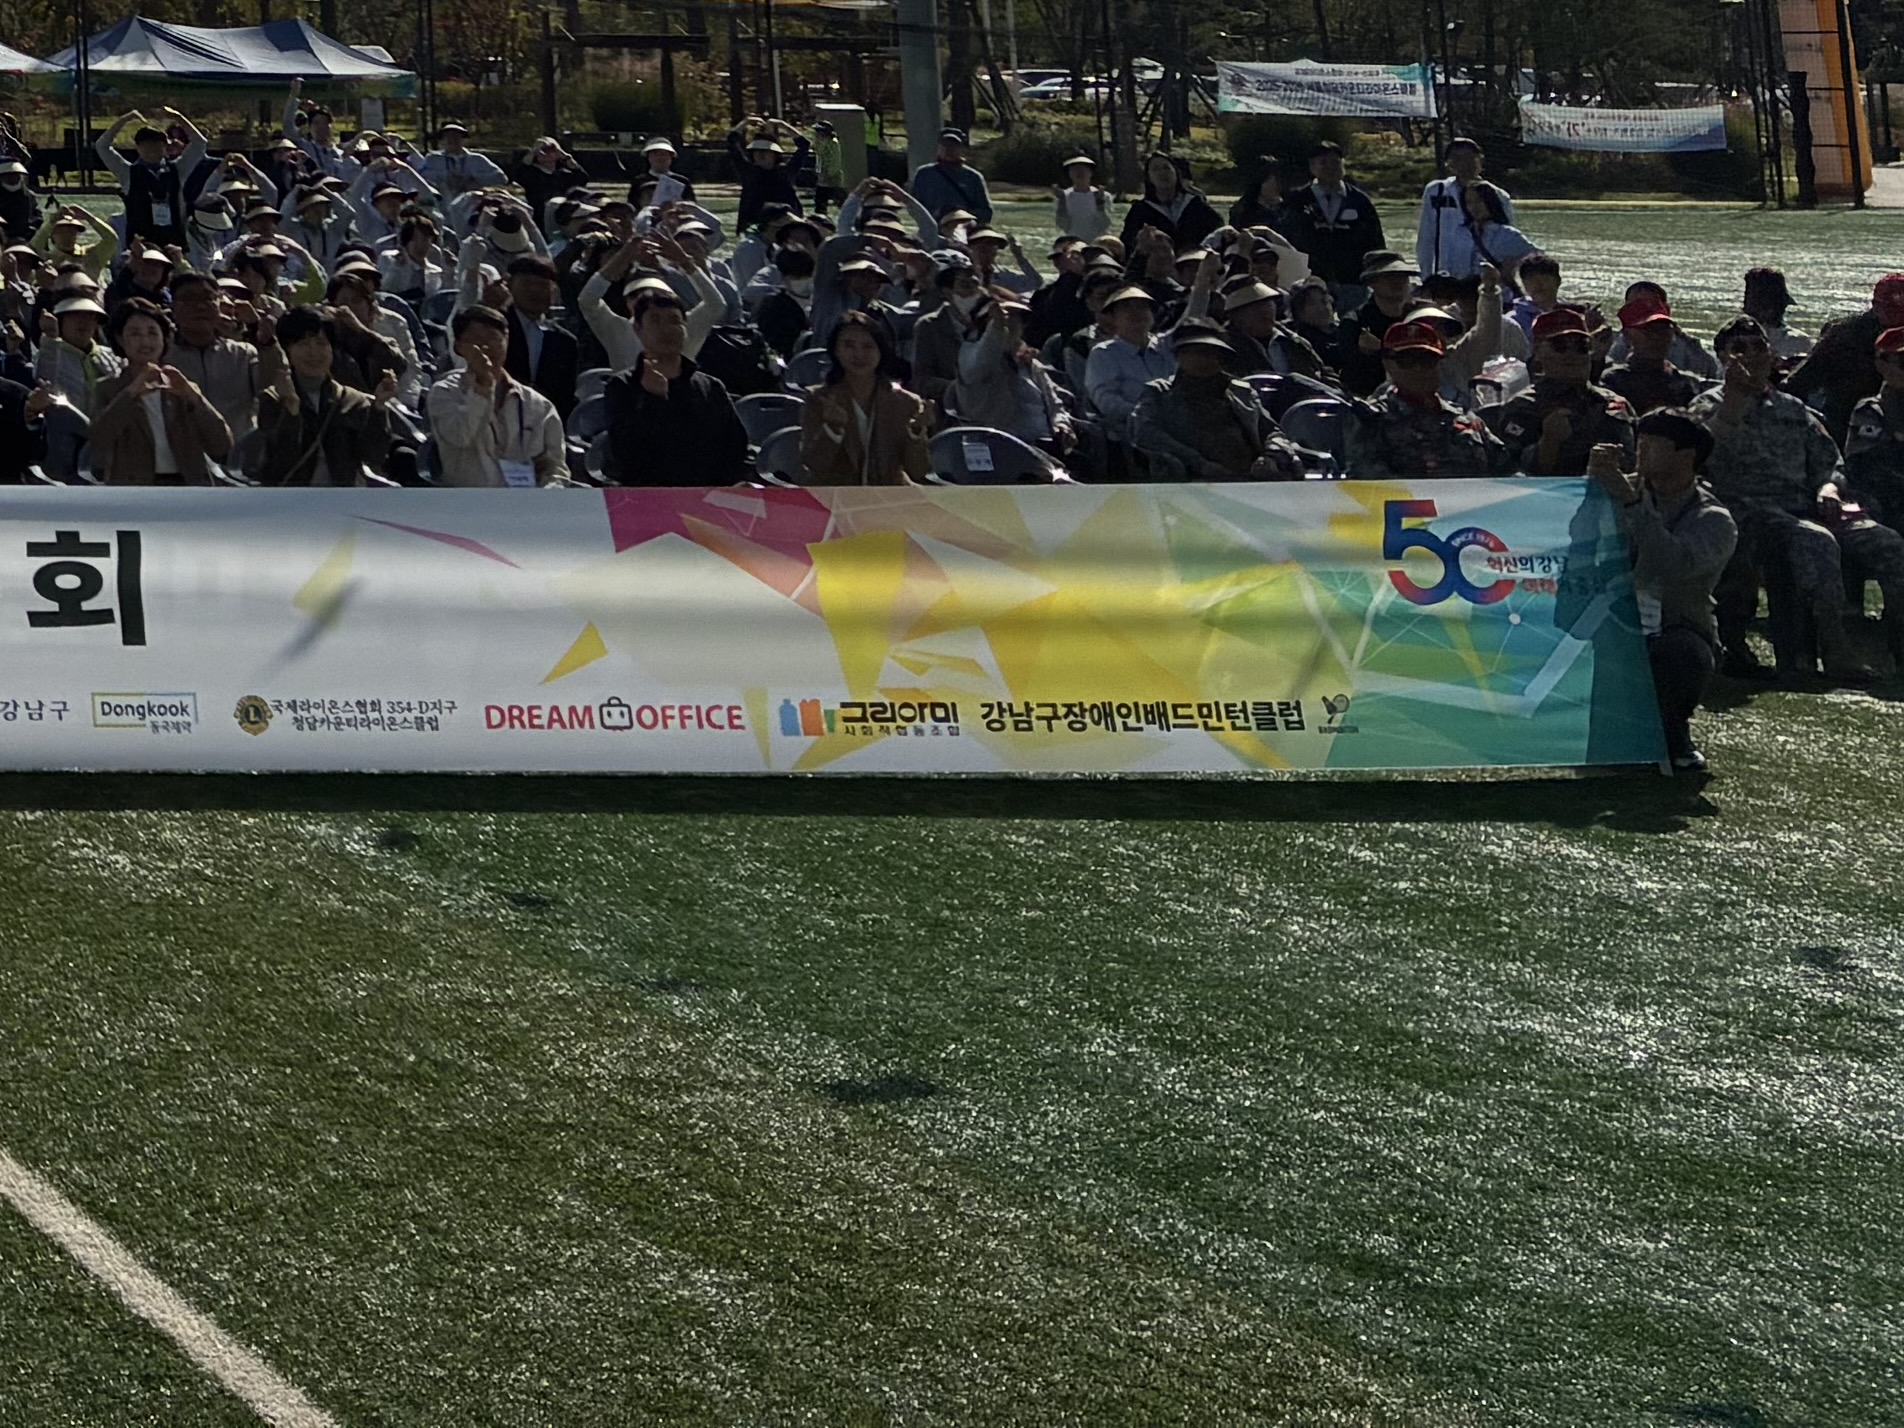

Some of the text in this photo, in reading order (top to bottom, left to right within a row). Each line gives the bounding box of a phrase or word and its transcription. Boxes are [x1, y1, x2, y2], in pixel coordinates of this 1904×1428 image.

[100, 700, 191, 721] Dongkook
[484, 703, 747, 731] DREAM OFFICE
[840, 701, 960, 724] 그리아미
[980, 699, 1306, 734] 강남구장애인배드민턴클럽
